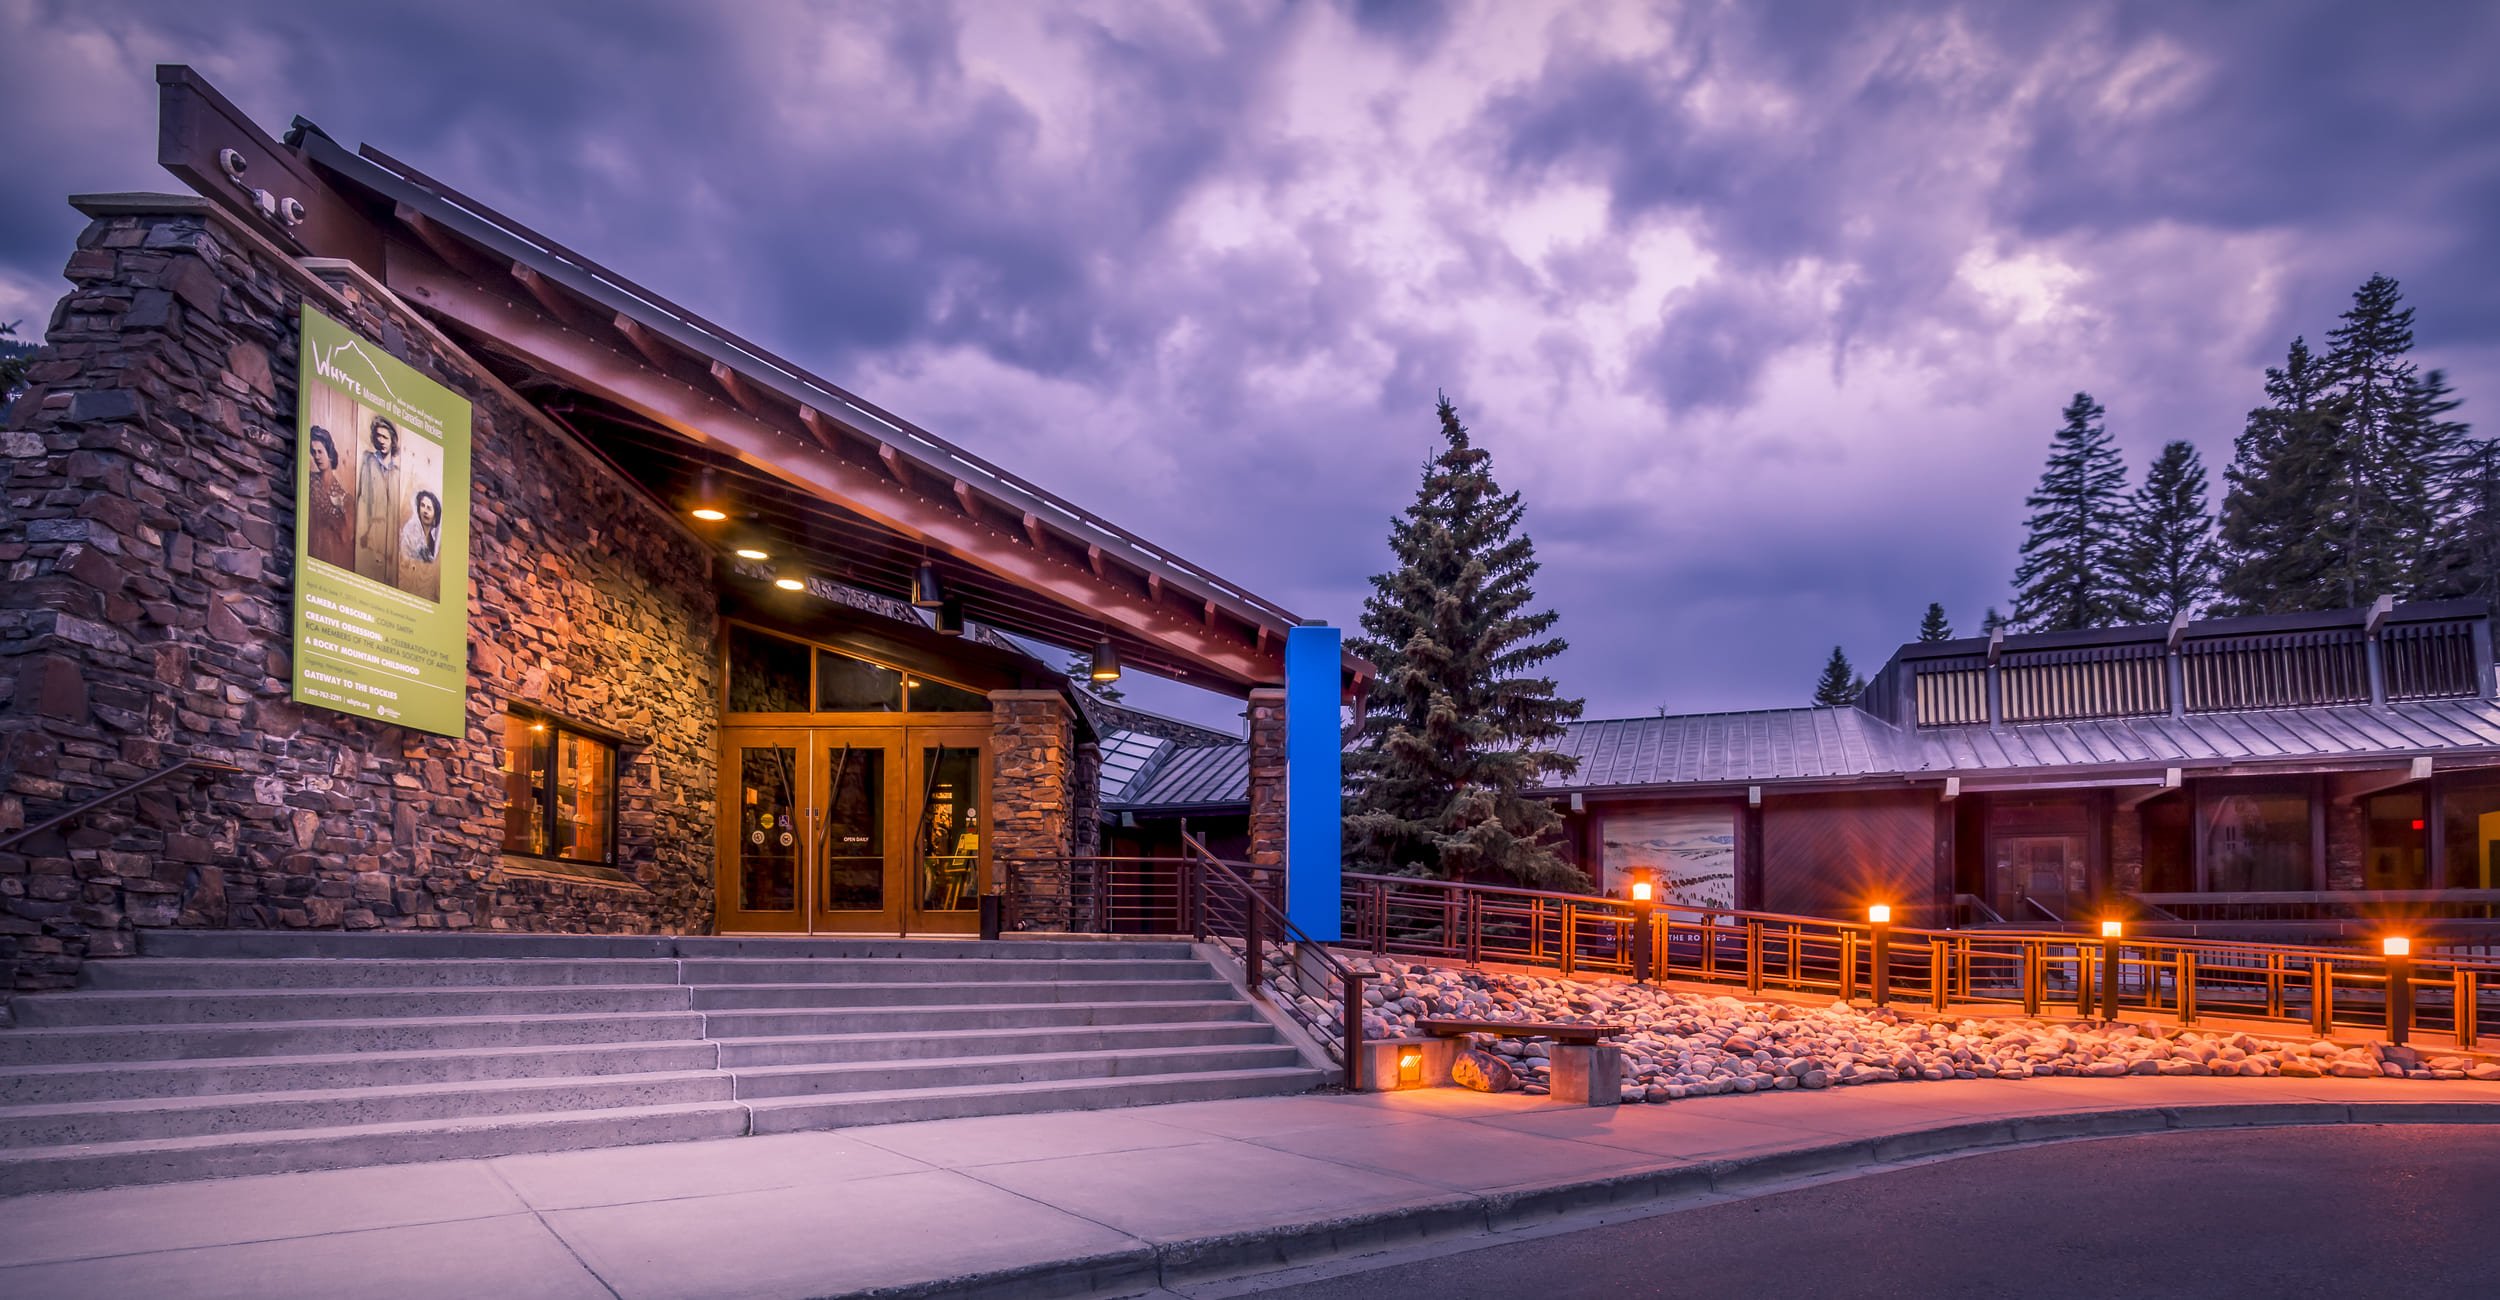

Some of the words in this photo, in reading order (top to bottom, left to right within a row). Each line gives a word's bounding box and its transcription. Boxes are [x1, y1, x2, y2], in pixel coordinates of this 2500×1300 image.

[311, 337, 361, 395] WHYTE
[305, 594, 338, 610] CAMERA
[396, 623, 414, 635] SMITH
[304, 636, 311, 645] A
[313, 638, 339, 653] ROCKY
[341, 646, 380, 665] MOUNTAIN
[381, 658, 420, 675] CHILDHOOD
[305, 611, 340, 628] CREATIVE
[391, 638, 429, 655] CELEBRATION
[430, 649, 438, 657] OF
[440, 652, 449, 661] THE
[305, 621, 320, 632] RCA
[322, 627, 351, 641] MEMBERS
[352, 636, 362, 644] OF
[364, 639, 374, 648] THE
[376, 644, 400, 656] ALBERTA
[402, 650, 425, 663] SOCIETY
[426, 658, 434, 666] OF
[304, 669, 341, 686] GATEWAY
[343, 679, 353, 689] TO
[355, 682, 368, 692] THE
[369, 686, 398, 700] ROCKIES
[1668, 934, 1684, 942] THE
